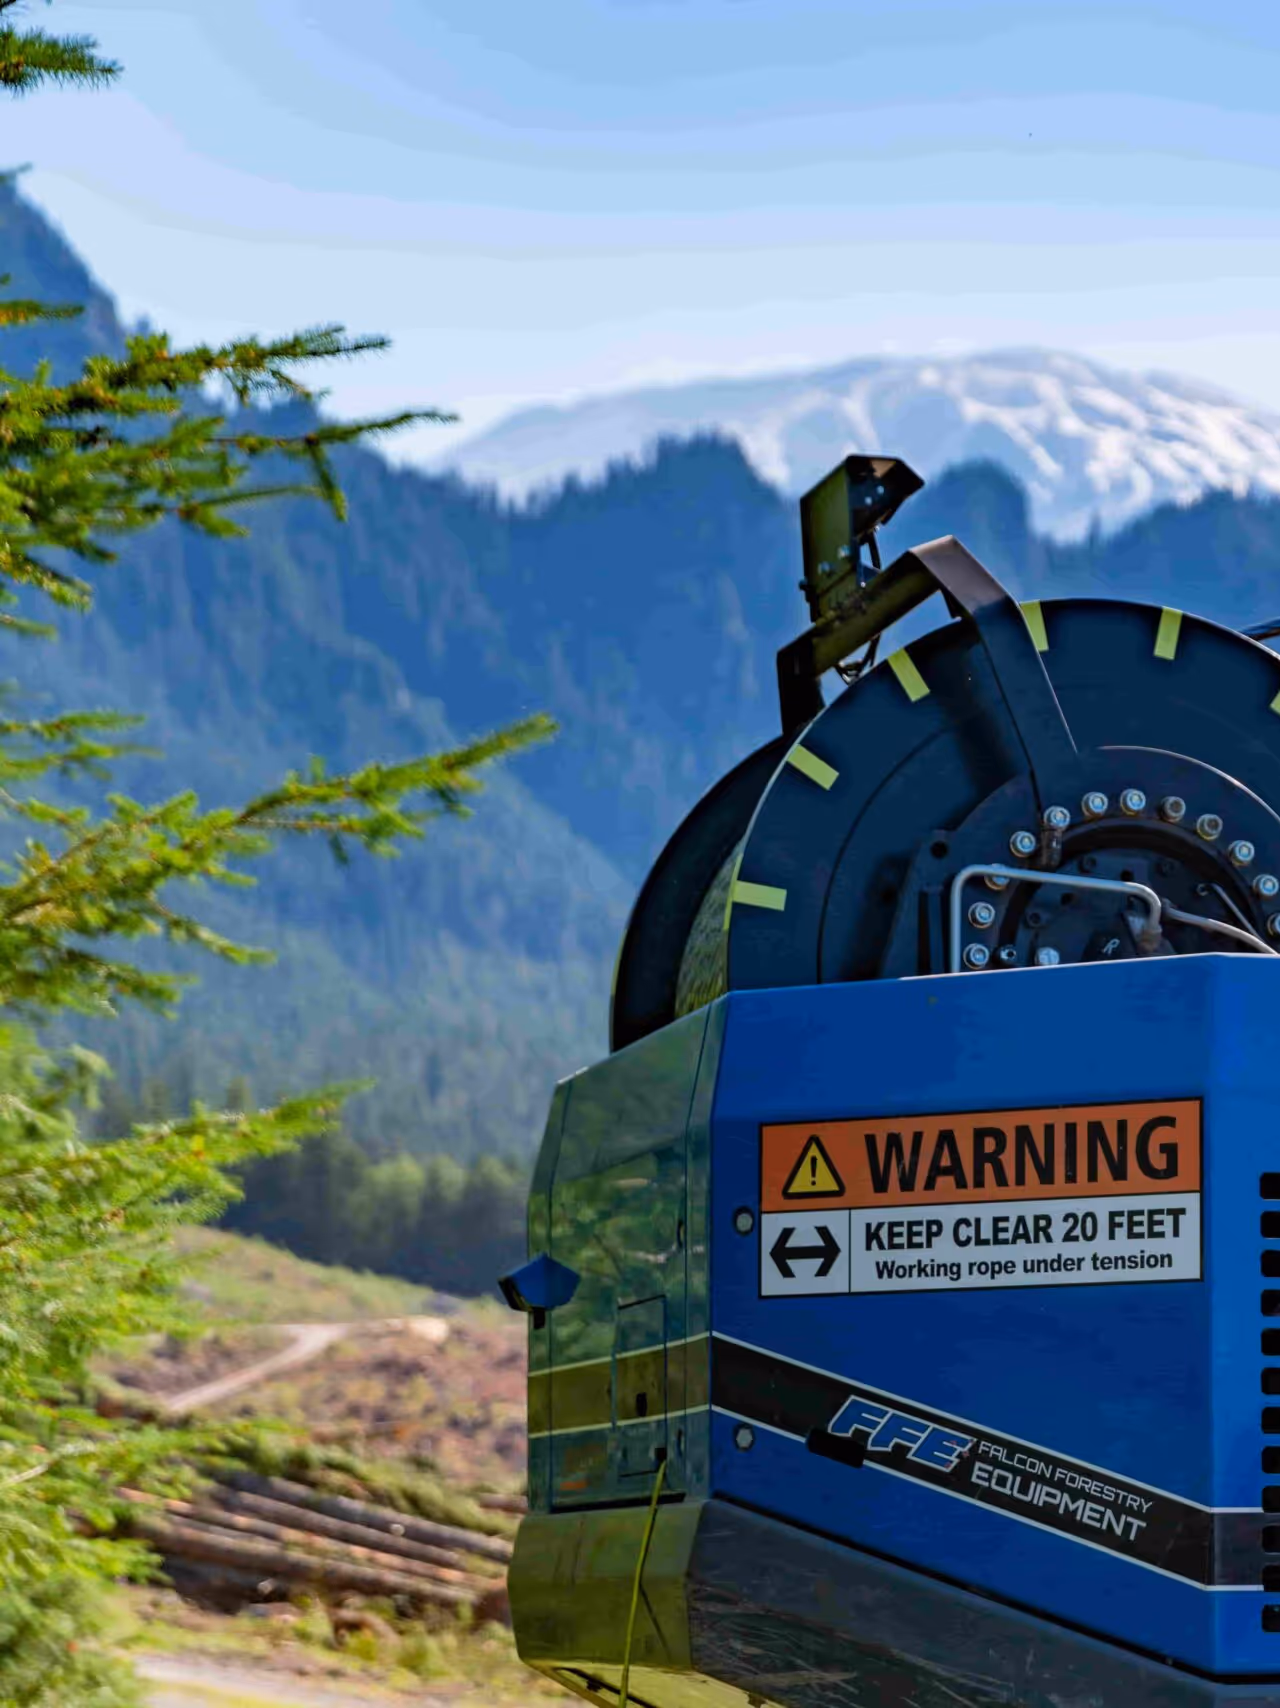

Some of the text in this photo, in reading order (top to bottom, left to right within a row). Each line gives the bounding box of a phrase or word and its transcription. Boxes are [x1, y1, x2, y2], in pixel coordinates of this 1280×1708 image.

[864, 1115, 1179, 1193] WARNING
[864, 1207, 1187, 1252] KEEP CLEAR 20 FEET
[875, 1249, 1174, 1282] Working rope under tension
[827, 1394, 977, 1473] FFE
[970, 1463, 1147, 1542] EQUIPMENT
[978, 1440, 1153, 1515] FALCON FORESTRY
